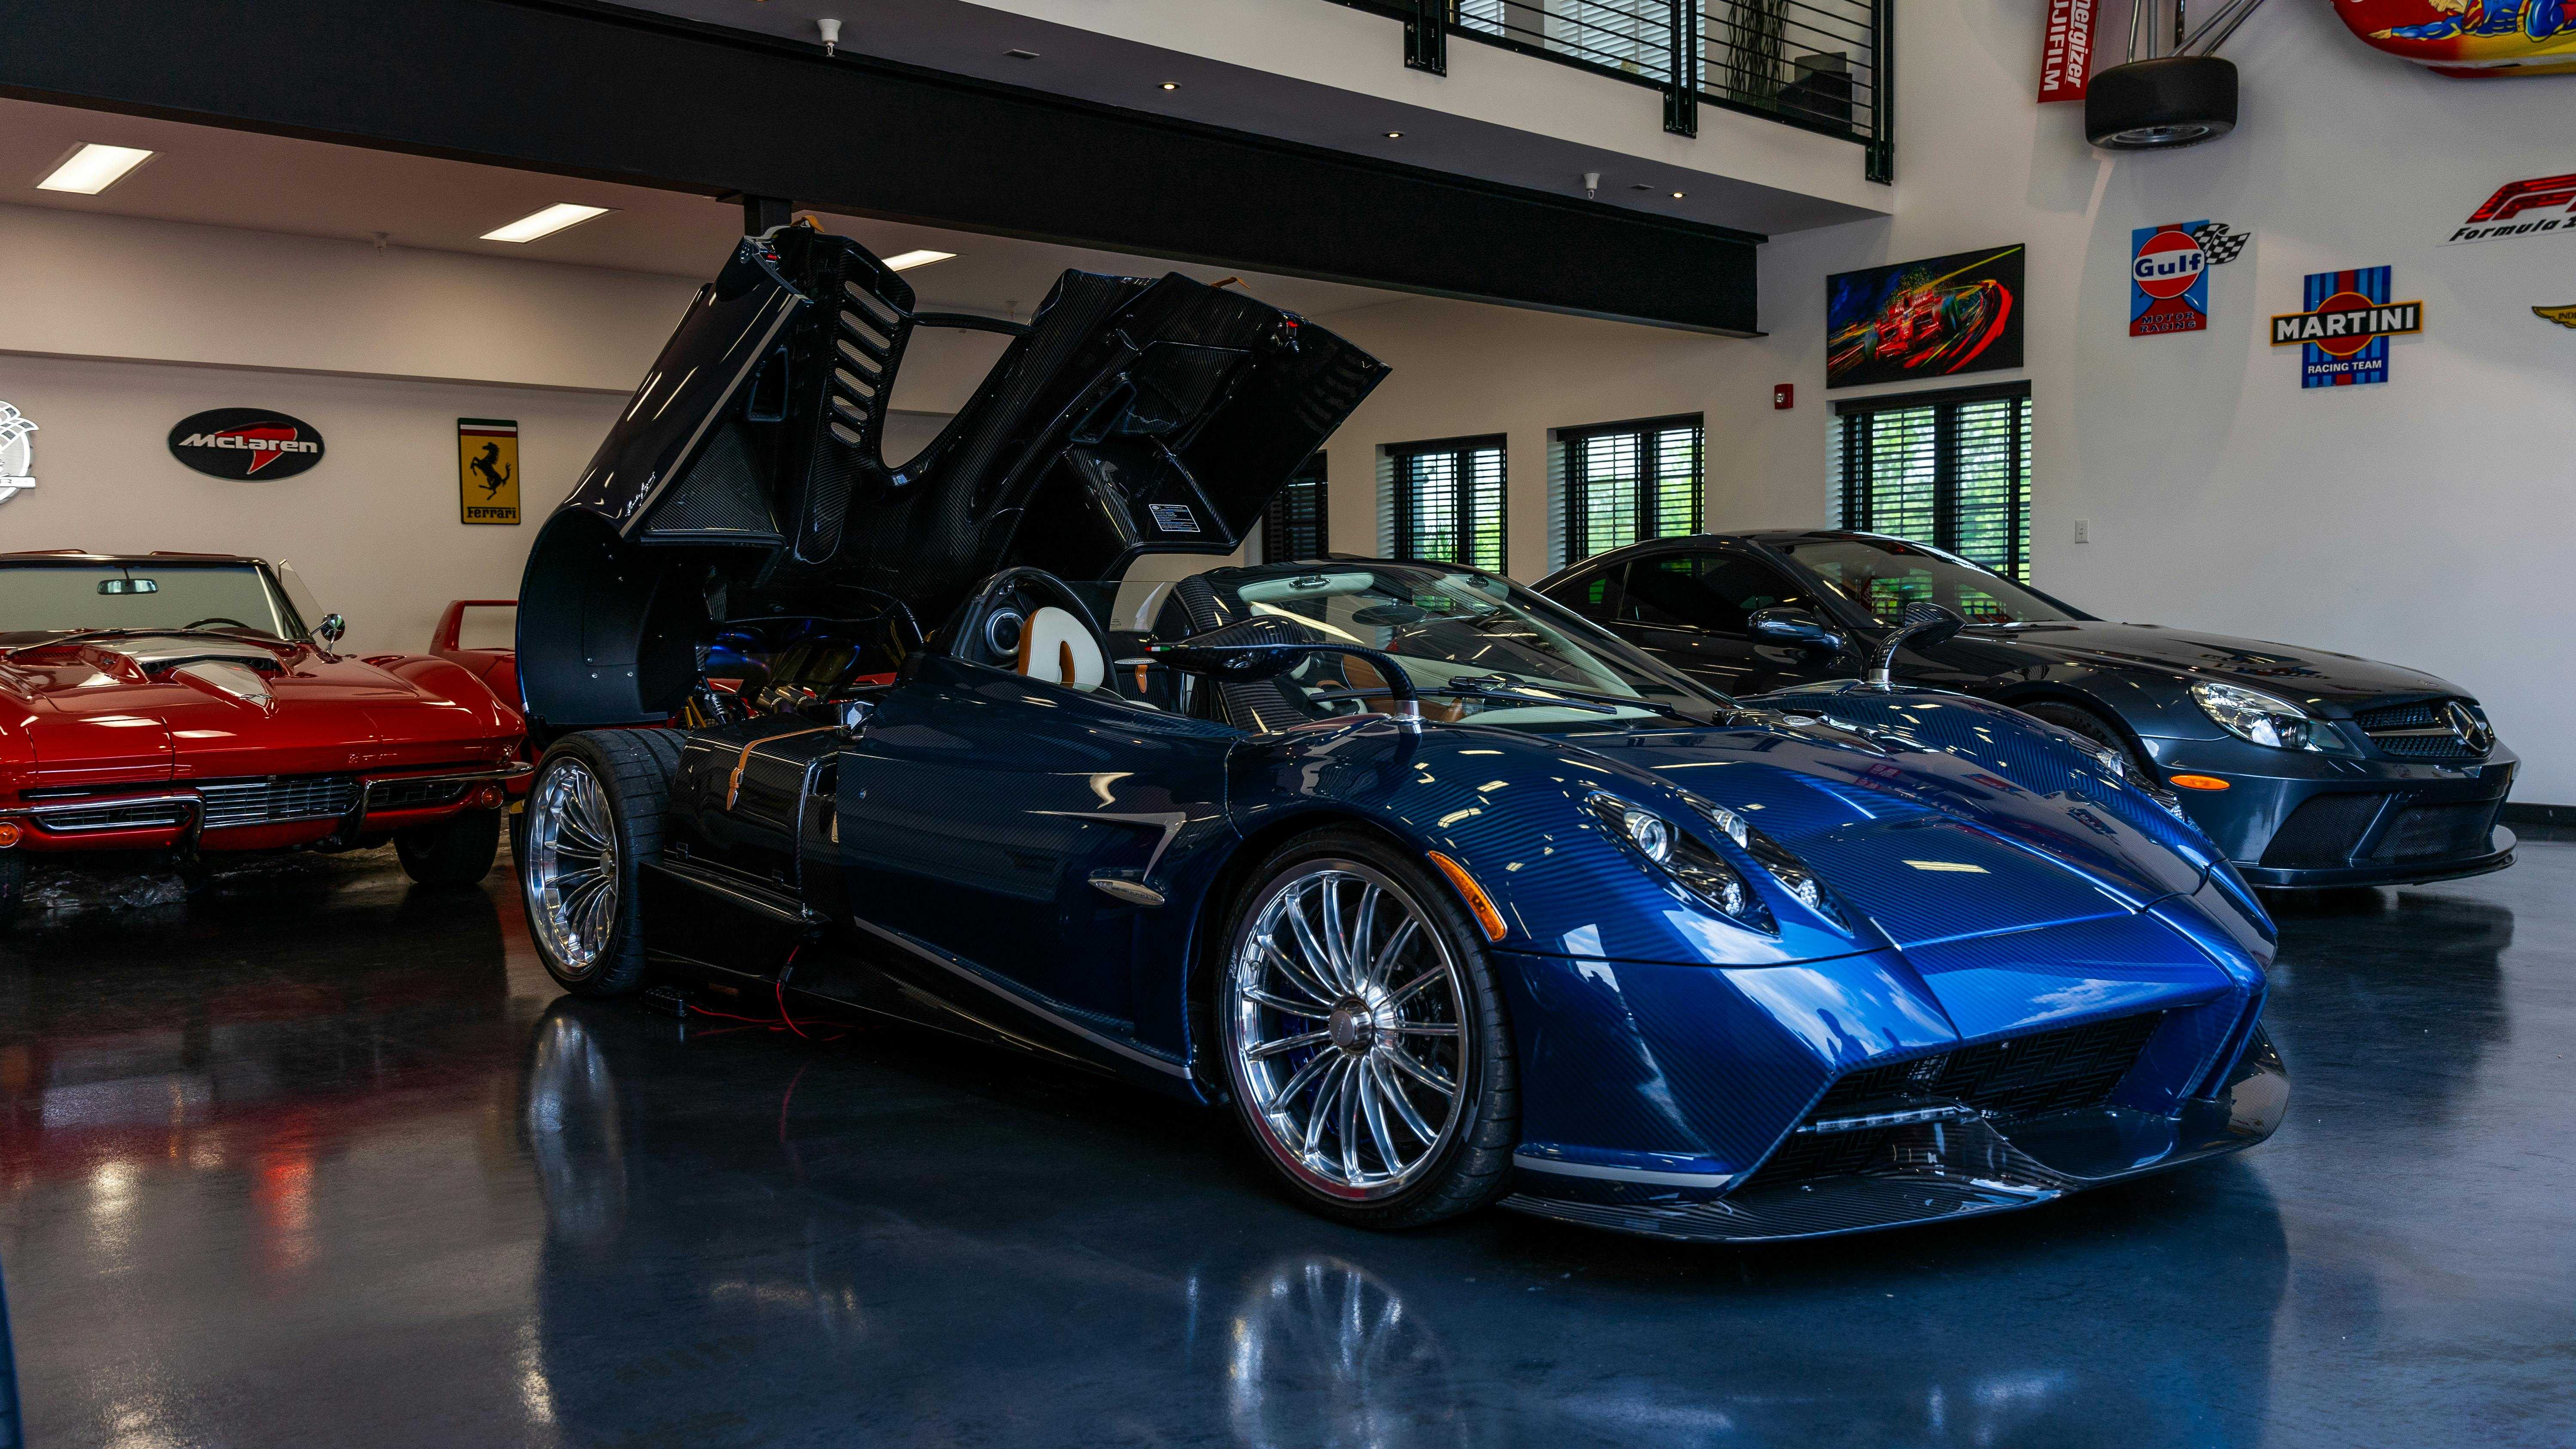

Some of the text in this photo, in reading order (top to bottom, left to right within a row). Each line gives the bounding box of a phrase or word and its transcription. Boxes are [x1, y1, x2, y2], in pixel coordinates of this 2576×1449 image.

[2448, 218, 2561, 242] Formula
[2135, 253, 2202, 278] Gulf
[2142, 312, 2195, 324] MOTOR
[2277, 306, 2414, 341] MARTINI
[2139, 321, 2196, 333] RACING
[2308, 360, 2382, 374] RACING TEAM
[178, 433, 317, 453] McLaren
[467, 506, 517, 519] Ferrari
